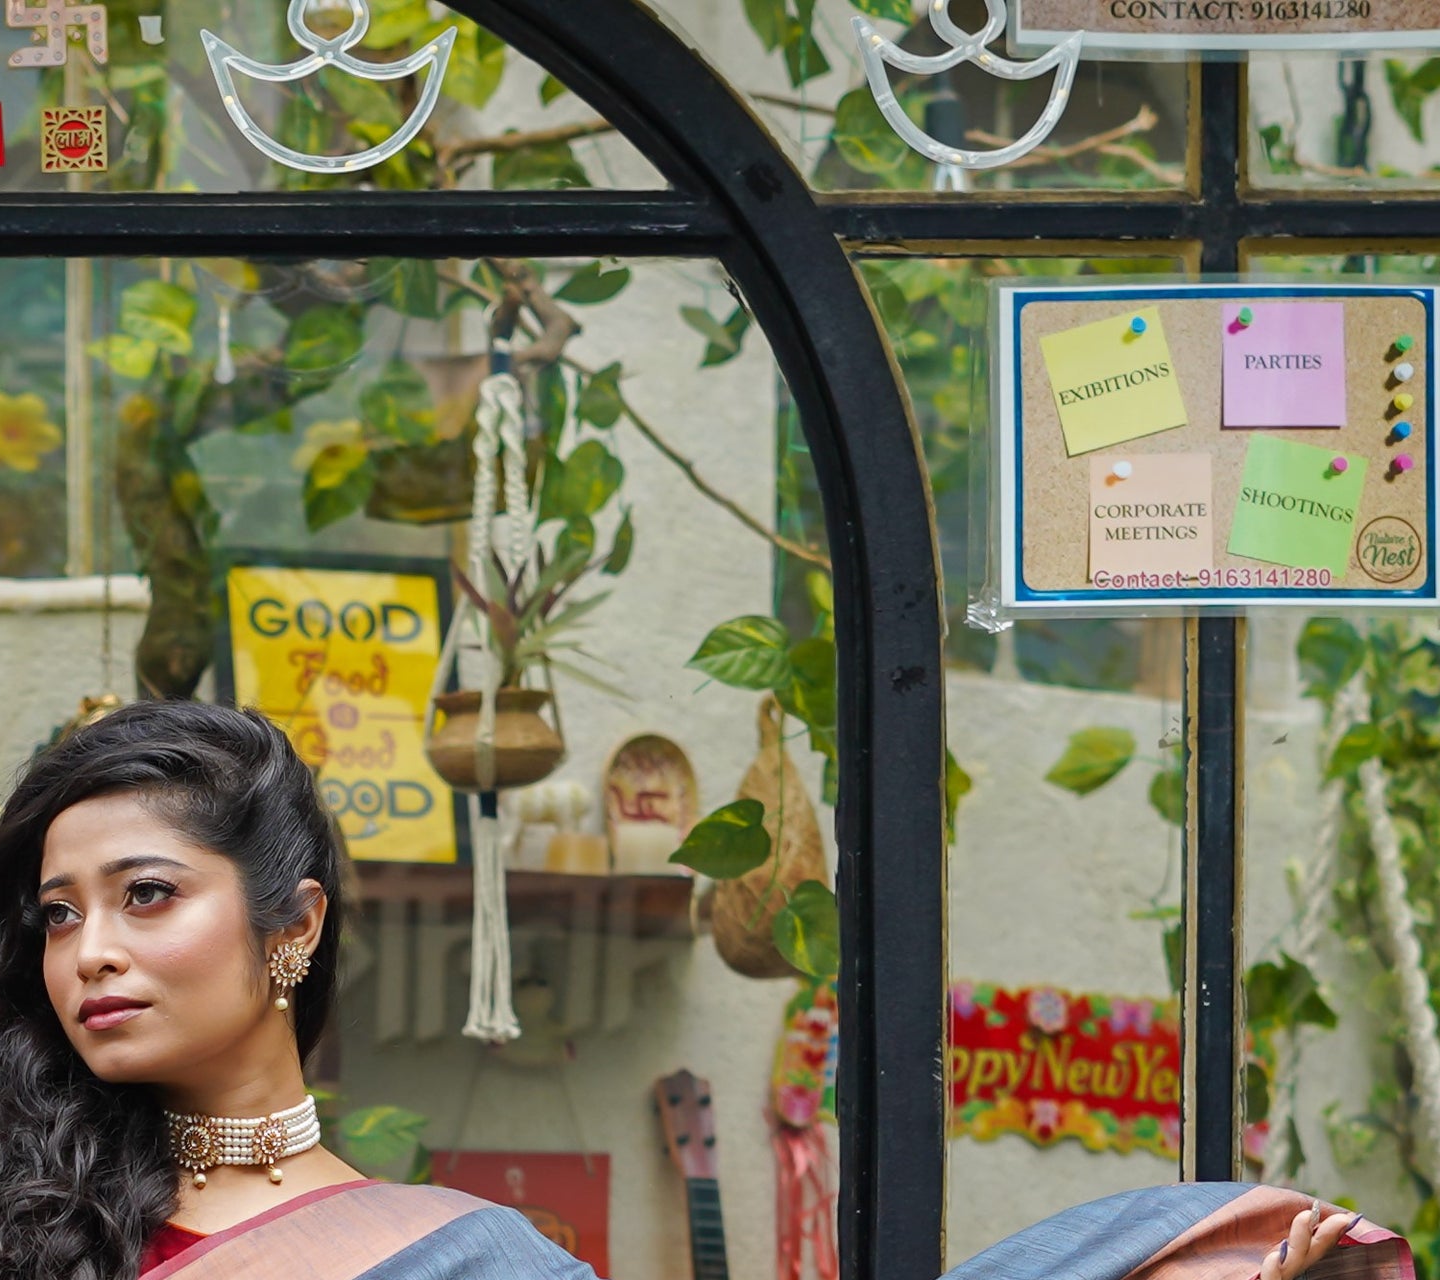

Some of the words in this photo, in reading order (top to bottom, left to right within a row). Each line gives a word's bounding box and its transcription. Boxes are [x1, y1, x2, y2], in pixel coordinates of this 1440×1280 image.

[1110, 0, 1244, 20] CONTACT:
[1251, 0, 1371, 20] 9163141280
[1243, 353, 1323, 371] PARTIES
[1058, 361, 1171, 406] EXIBITIONS
[1093, 502, 1208, 519] CORPORATE
[1240, 487, 1355, 524] SHOOTINGS
[1104, 525, 1199, 541] MEETINGS
[1362, 545, 1416, 568] Nest
[1094, 569, 1190, 589] Contact:
[1198, 567, 1331, 588] 9163141280
[248, 597, 423, 643] GOOD
[288, 649, 390, 697] Food
[319, 777, 435, 819] OOD
